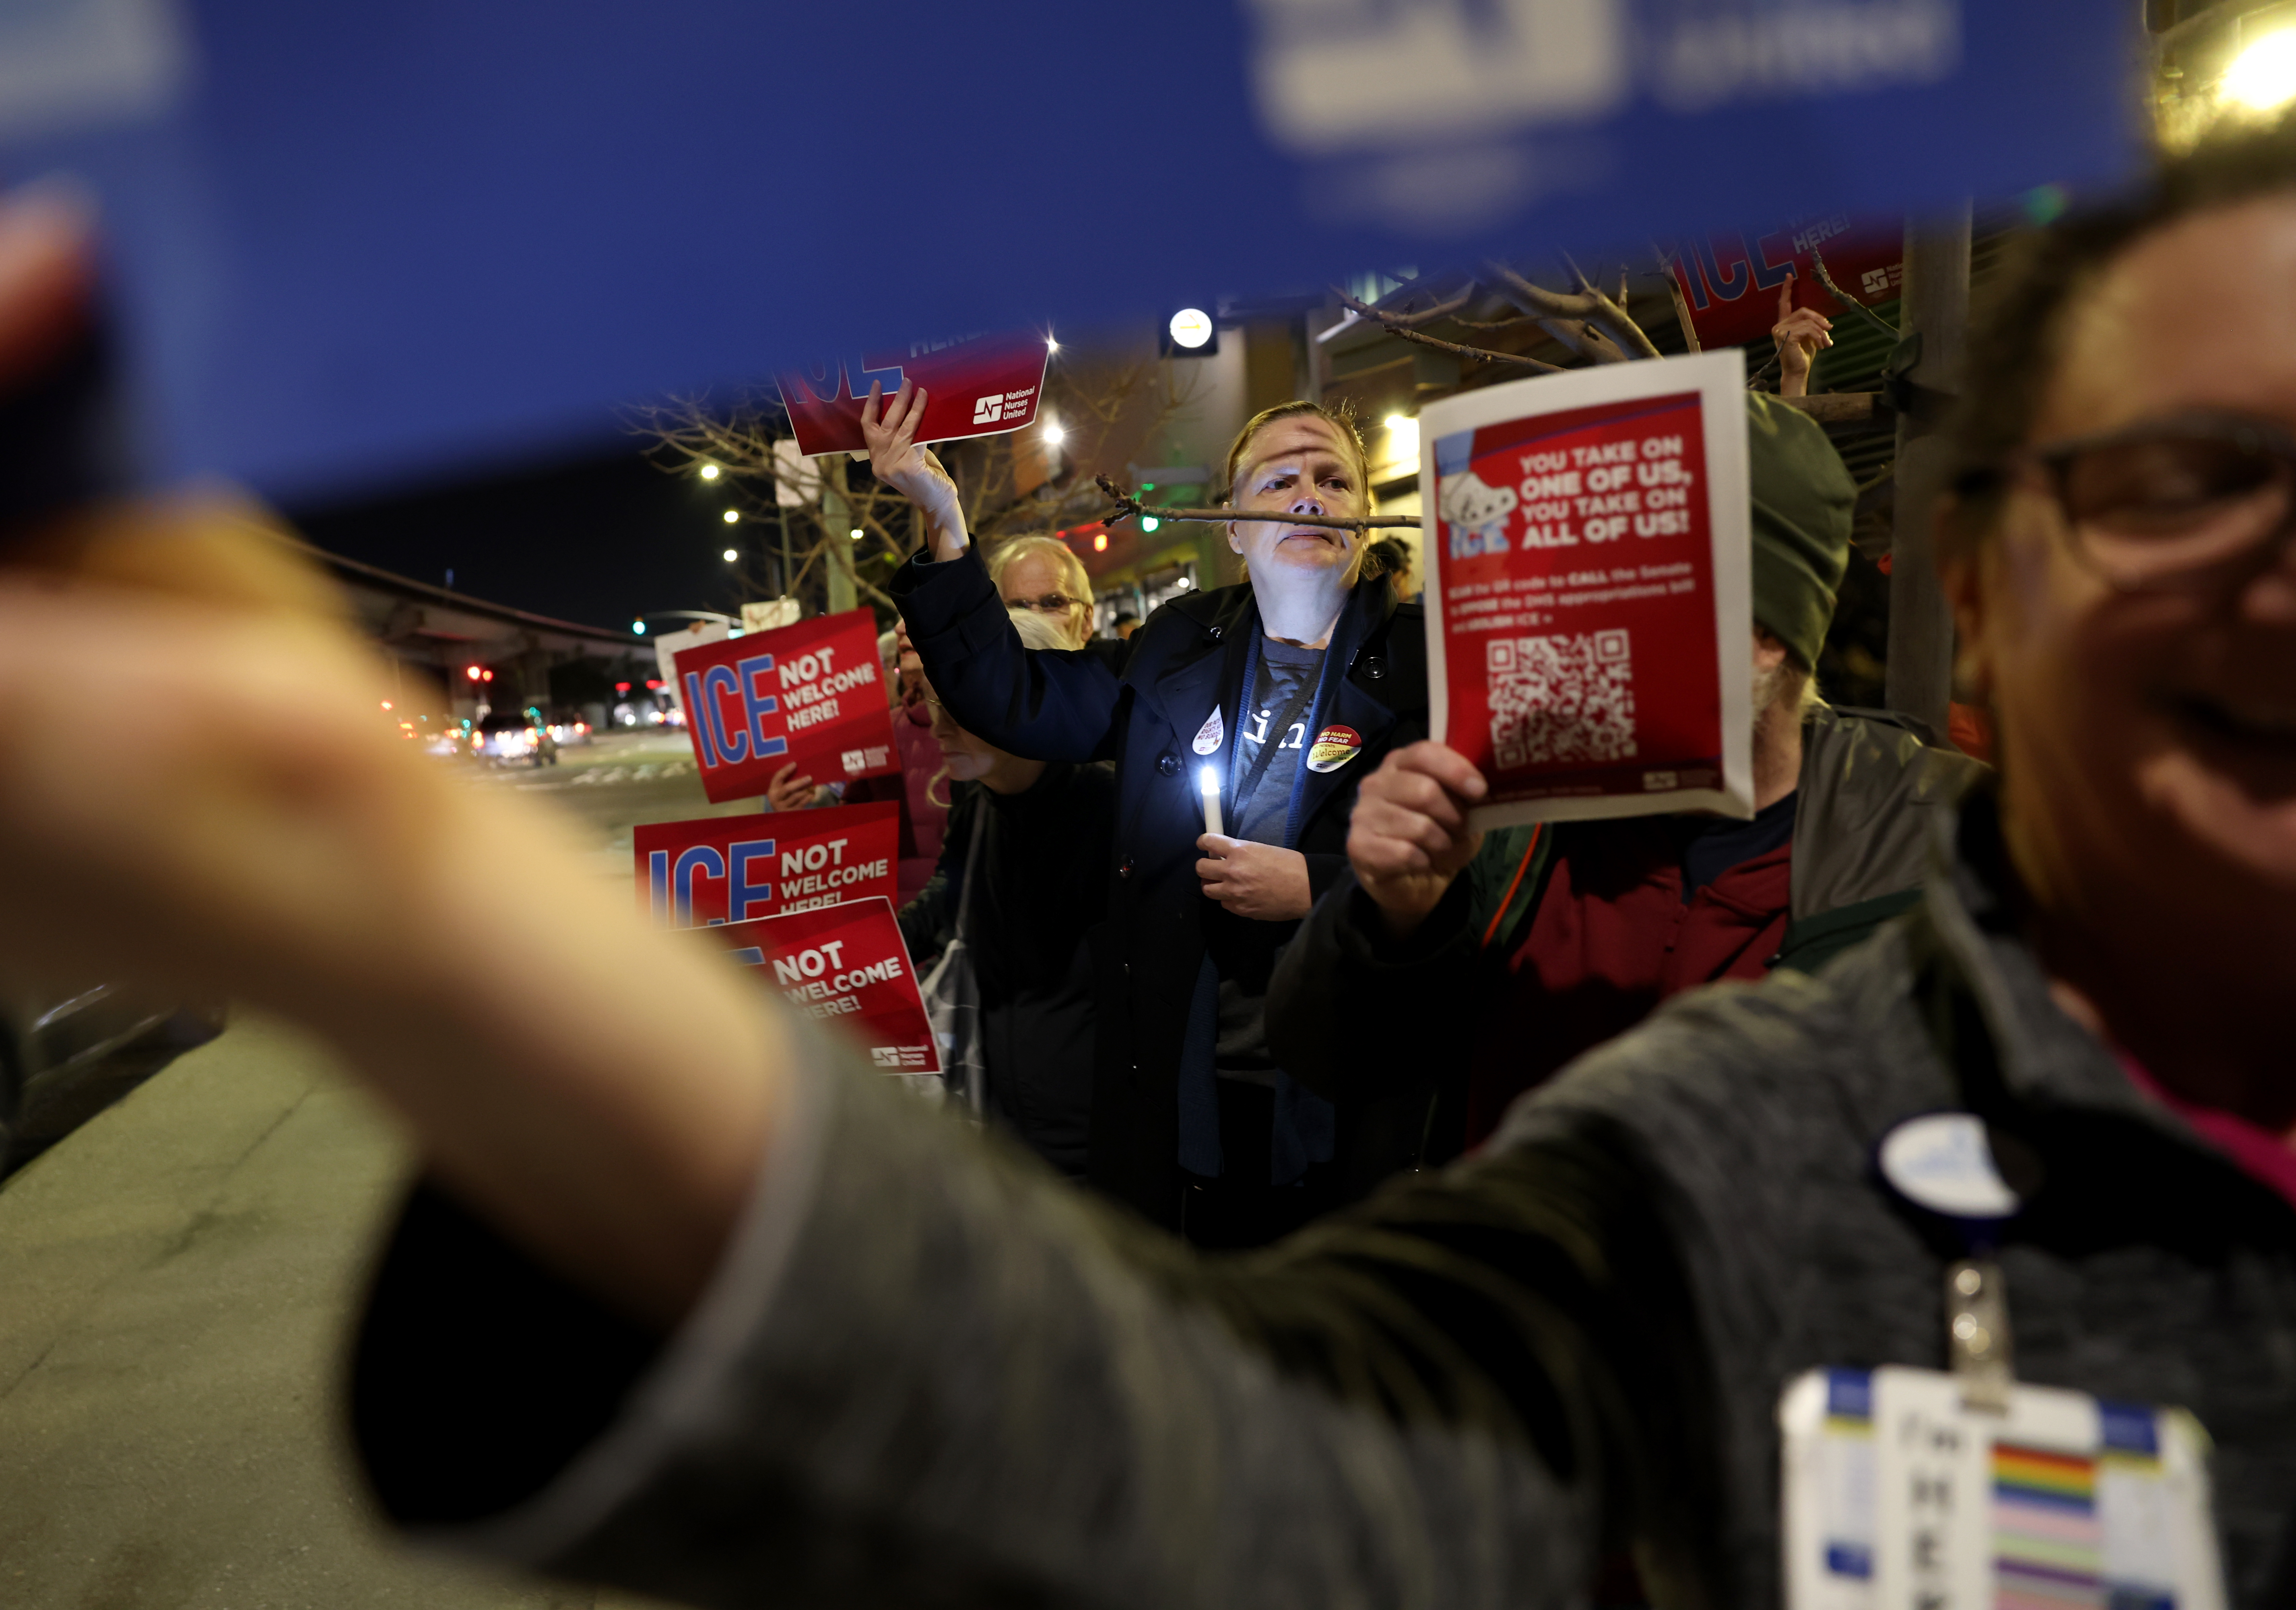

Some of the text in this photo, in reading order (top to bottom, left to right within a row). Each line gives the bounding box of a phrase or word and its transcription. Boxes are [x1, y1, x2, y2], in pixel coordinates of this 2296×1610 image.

[1792, 212, 1851, 255] HERE!
[1003, 407, 1027, 420] United
[1004, 398, 1028, 411] Nurses
[1005, 385, 1035, 401] National
[1520, 435, 1683, 474] YOU TAKE ON
[1520, 459, 1692, 501] ONE OF US,
[1521, 487, 1686, 522] YOU TAKE ON
[1522, 509, 1689, 550] ALL OF US!
[1568, 569, 1607, 586] CALL
[778, 646, 835, 689] NOT
[782, 662, 877, 710] WELCOME
[685, 653, 788, 768] ICE
[786, 698, 840, 732] HERE!
[1312, 748, 1351, 760] Welcome
[781, 838, 848, 878] NOT
[649, 838, 776, 931] ICE
[780, 859, 888, 900] WELCOME
[772, 939, 844, 986] NOT
[783, 956, 903, 1004] WELCOME
